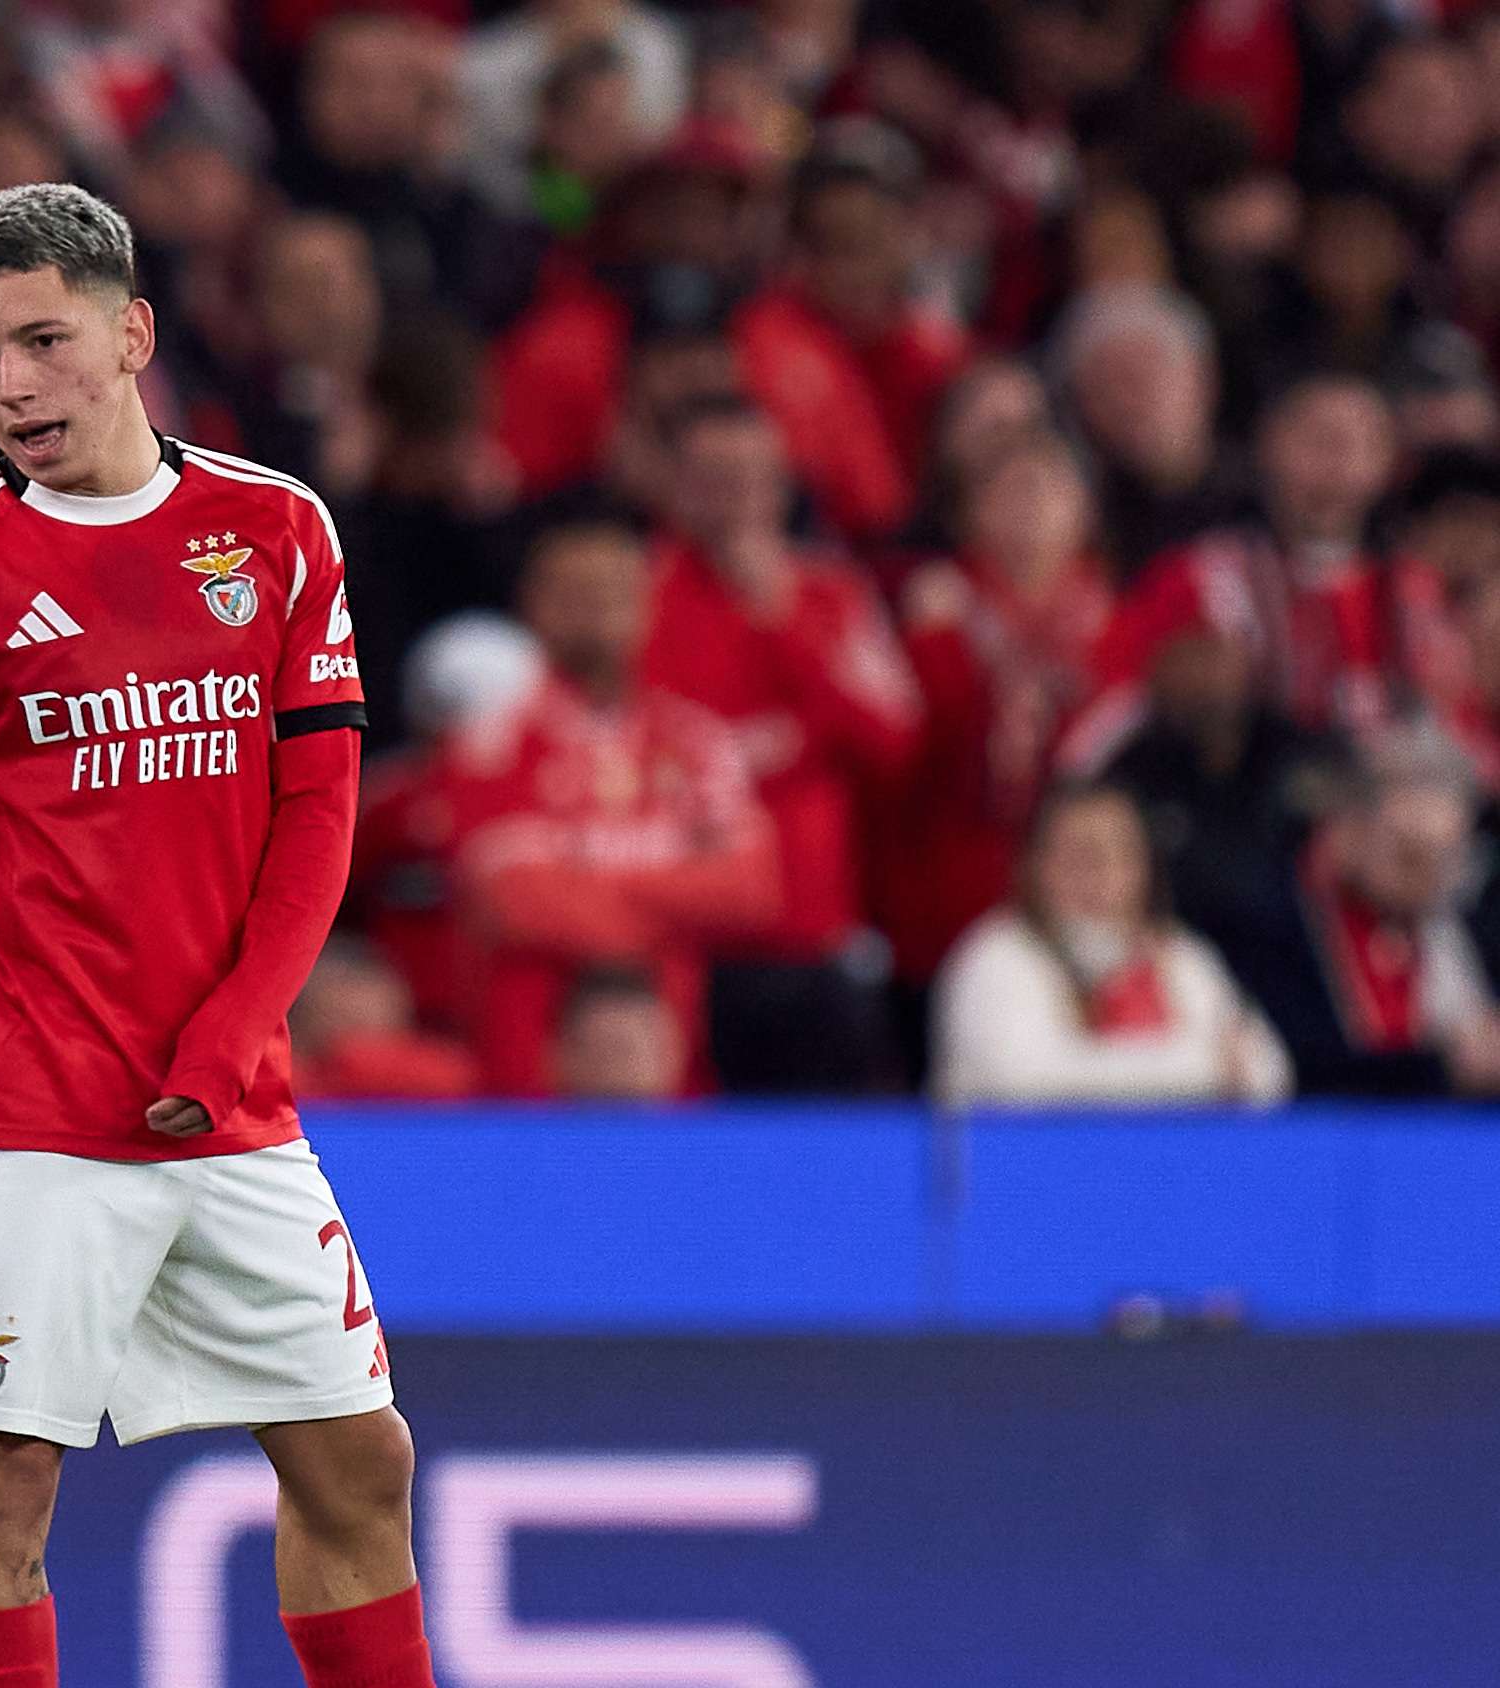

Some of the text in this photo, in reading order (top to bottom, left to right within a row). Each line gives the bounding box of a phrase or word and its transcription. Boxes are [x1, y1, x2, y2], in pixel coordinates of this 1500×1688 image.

[310, 654, 359, 682] Beta
[18, 668, 260, 744] Emirates
[71, 729, 238, 791] FLY BETTER
